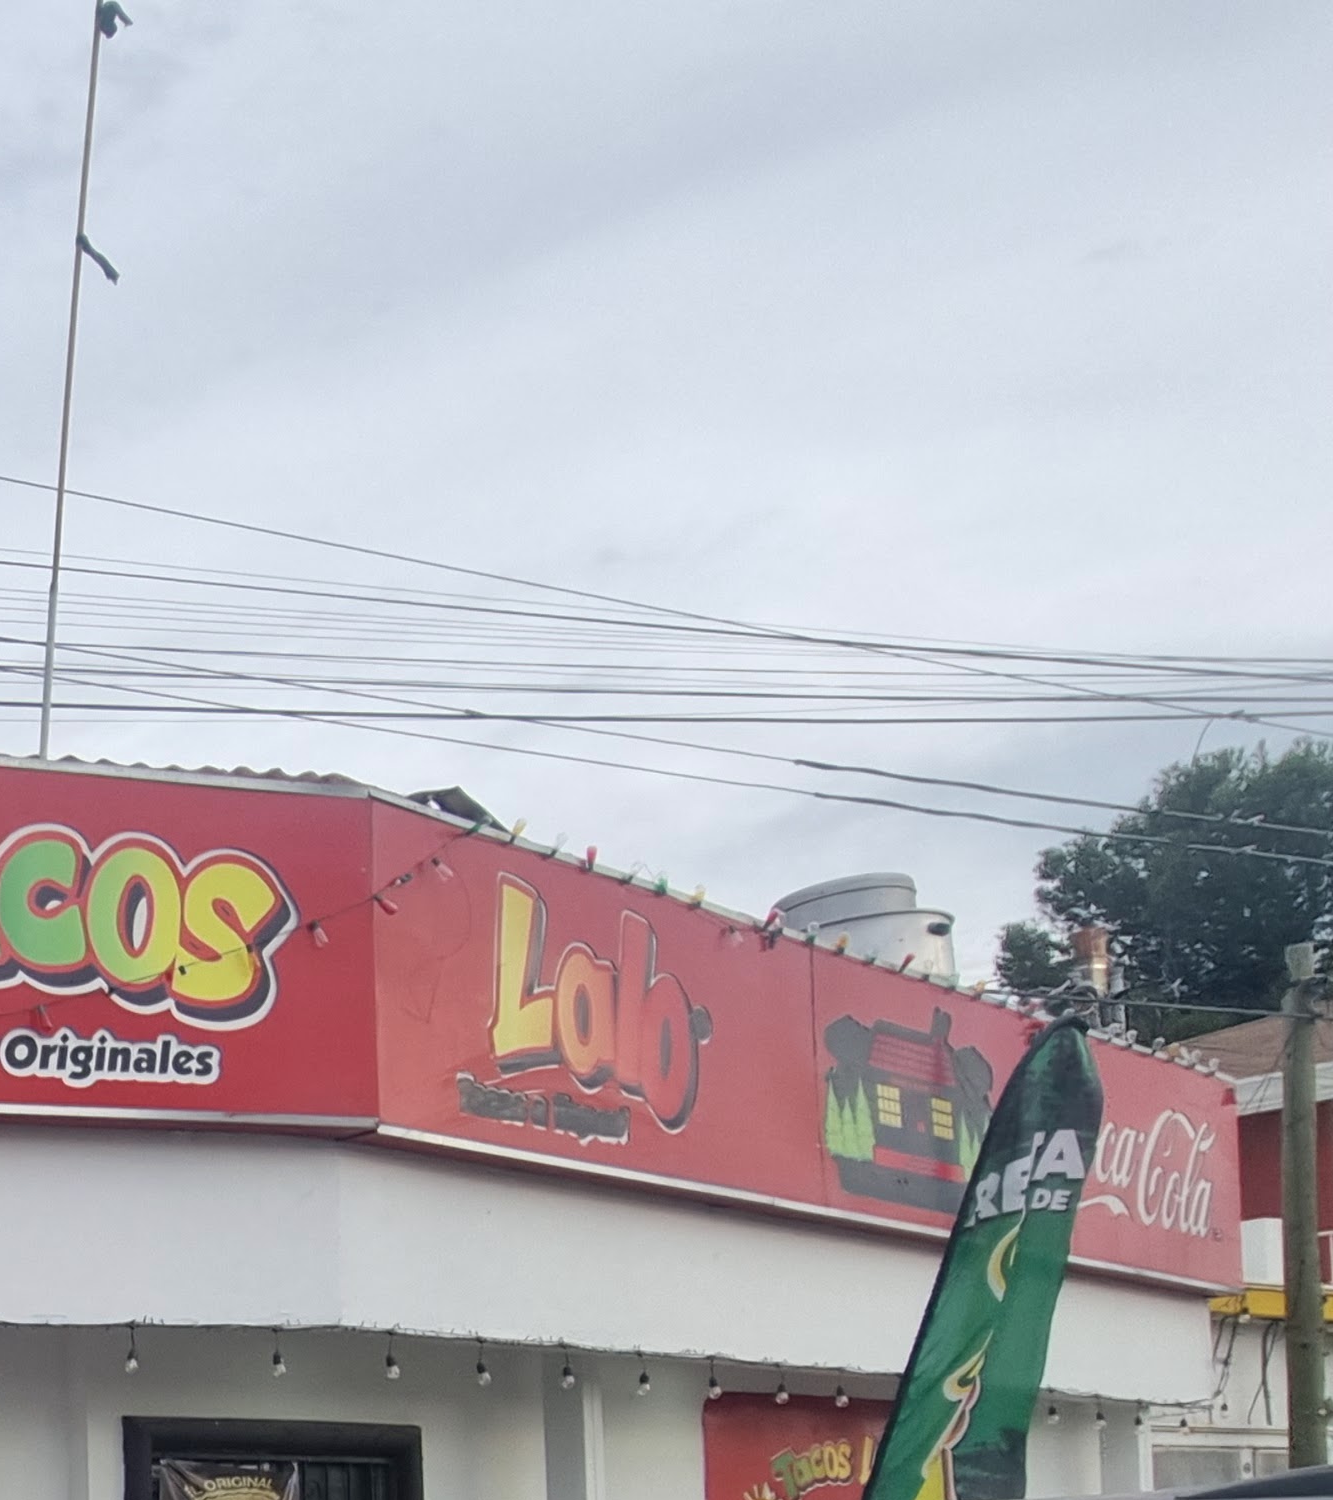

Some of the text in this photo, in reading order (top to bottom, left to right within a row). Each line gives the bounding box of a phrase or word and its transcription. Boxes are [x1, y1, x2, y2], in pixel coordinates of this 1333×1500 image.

[4, 1032, 214, 1080] Originales
[1030, 1187, 1073, 1211] DE
[203, 1475, 273, 1492] ORIGINAL
